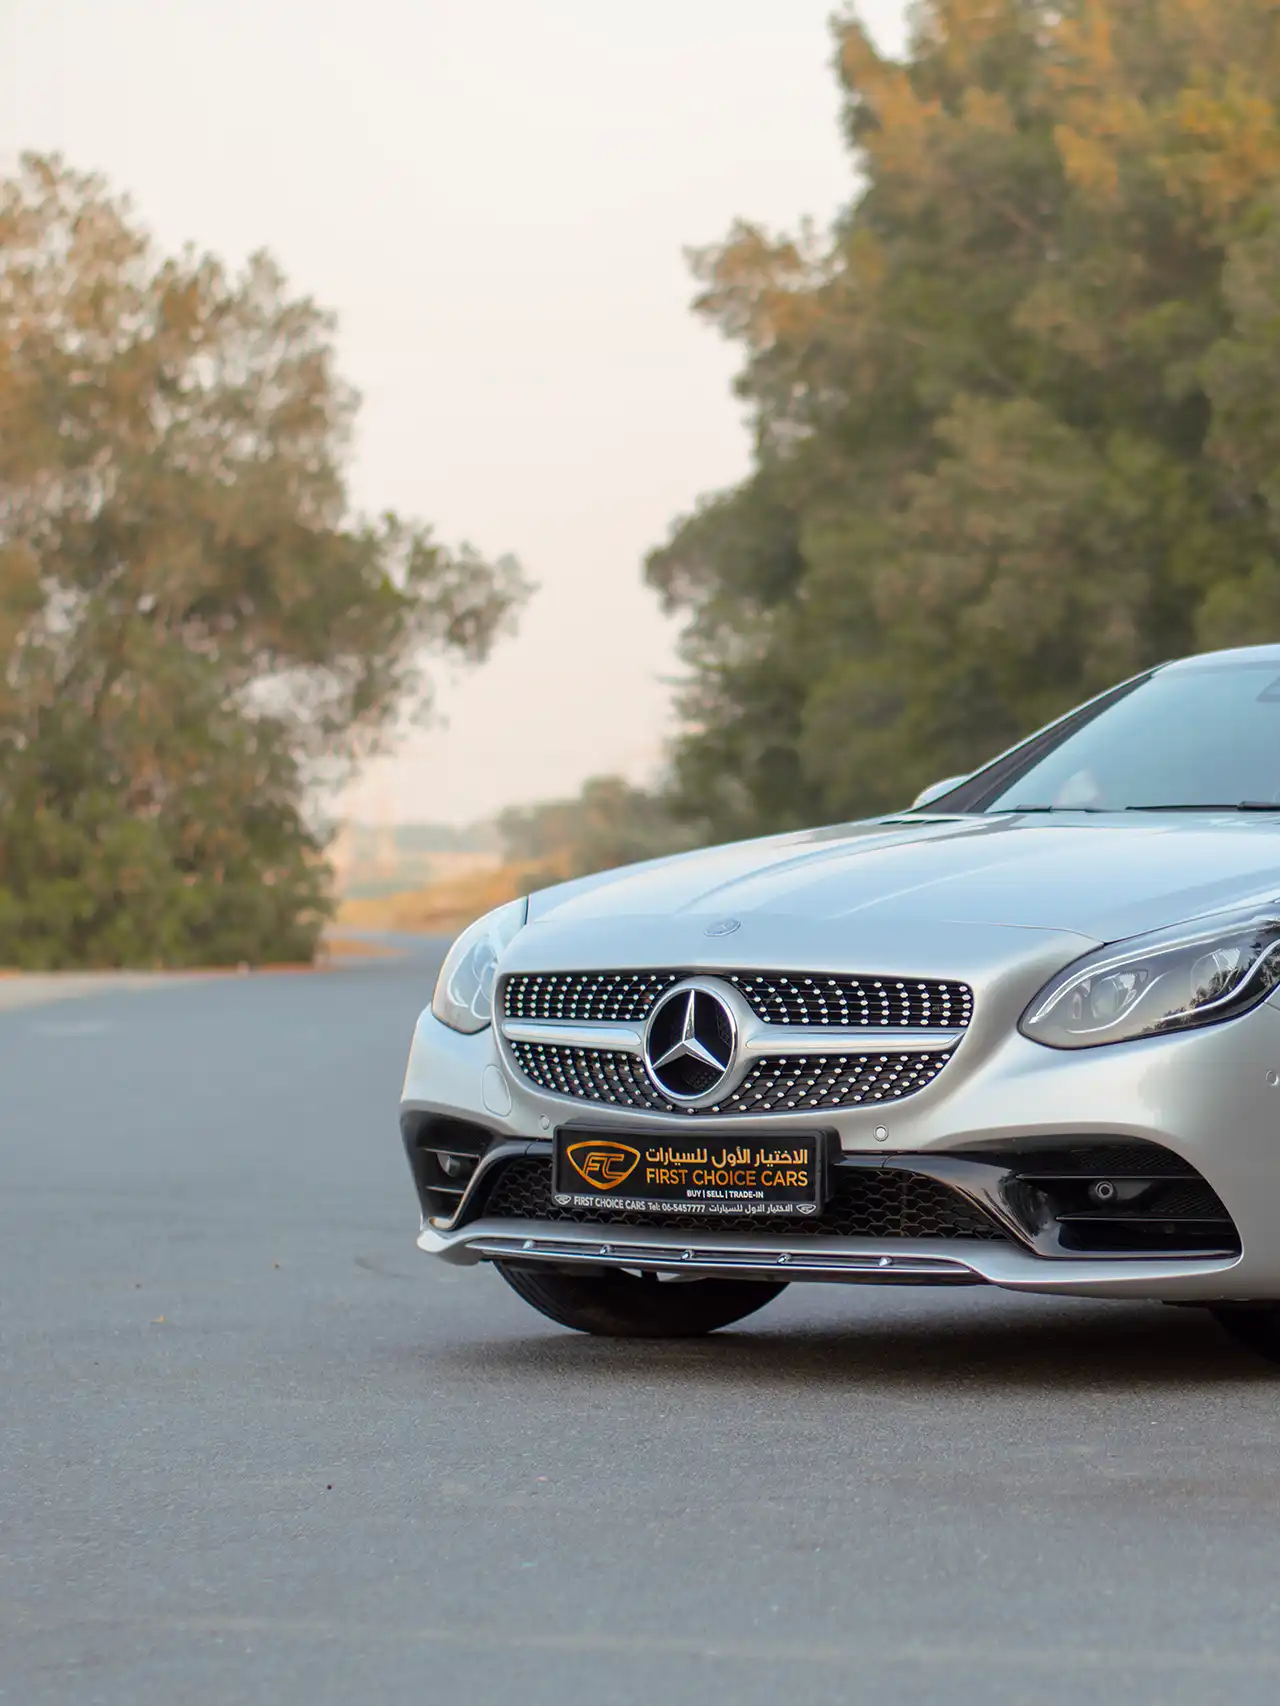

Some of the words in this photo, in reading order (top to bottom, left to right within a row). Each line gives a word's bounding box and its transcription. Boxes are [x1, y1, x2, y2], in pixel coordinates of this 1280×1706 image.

[645, 1147, 708, 1166] للسيارات
[711, 1145, 751, 1169] الأول
[754, 1148, 808, 1168] الاختيار
[646, 1167, 689, 1185] FIRST
[692, 1169, 757, 1187] CHOICE
[761, 1170, 808, 1187] CARS
[686, 1189, 702, 1198] BUY
[706, 1190, 724, 1199] SELL
[729, 1190, 764, 1199] TRADE-IN
[573, 1195, 594, 1207] FIRST
[594, 1197, 624, 1209] CHOICE
[625, 1201, 646, 1211] CARS
[648, 1202, 661, 1211] Tel:
[661, 1203, 706, 1213] 06-5457777
